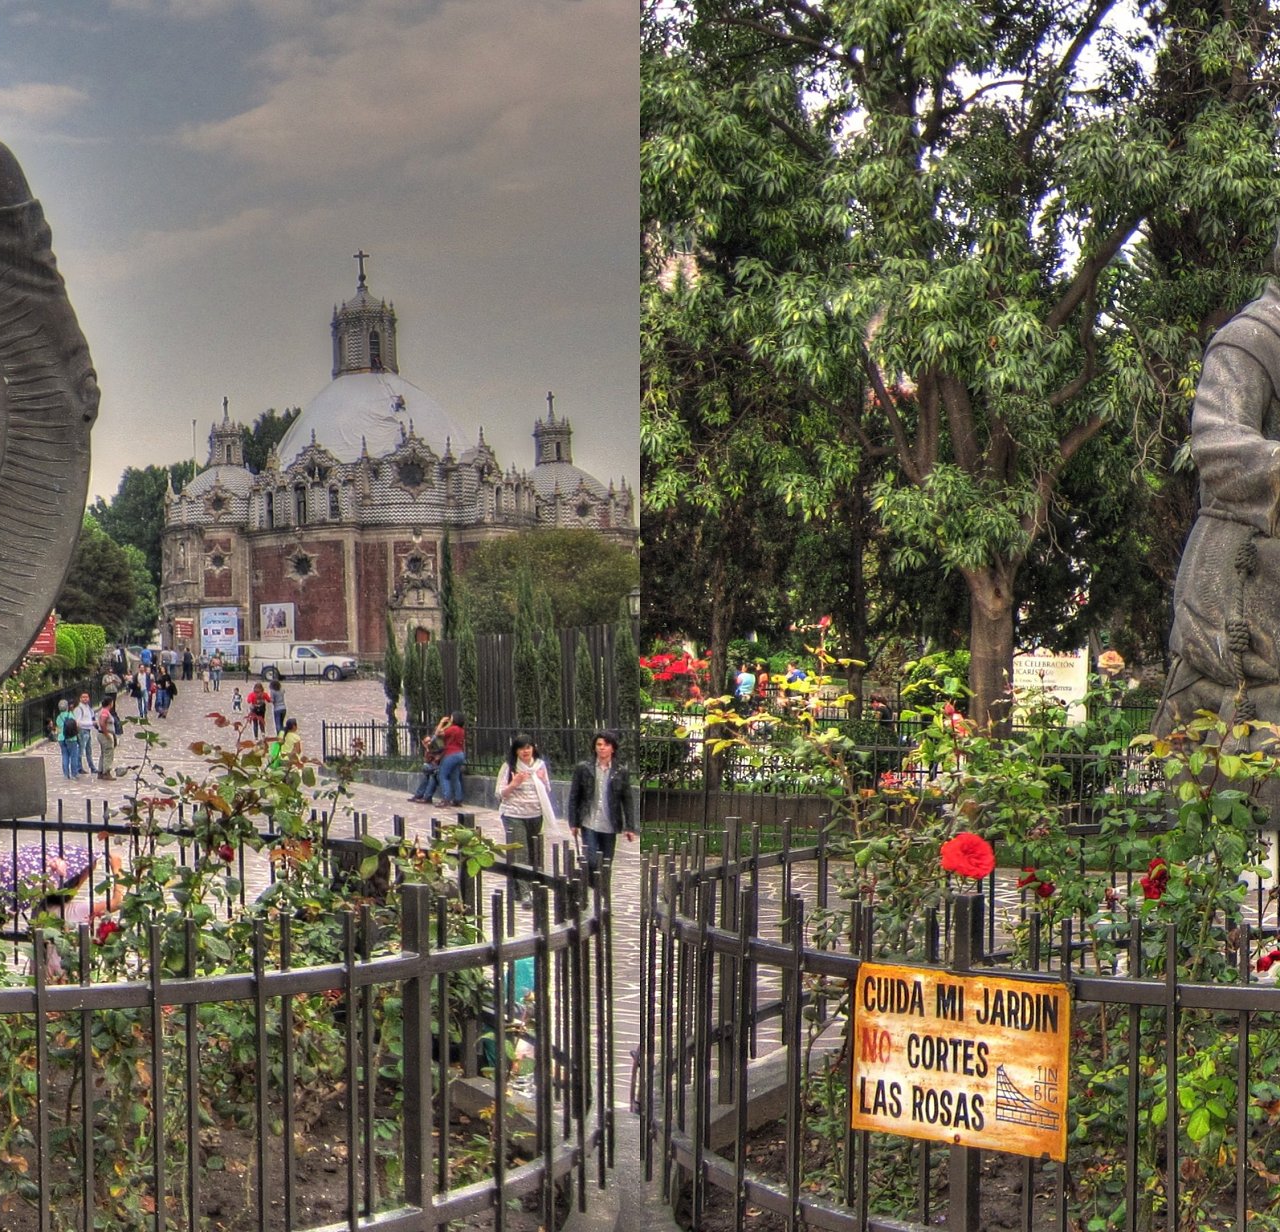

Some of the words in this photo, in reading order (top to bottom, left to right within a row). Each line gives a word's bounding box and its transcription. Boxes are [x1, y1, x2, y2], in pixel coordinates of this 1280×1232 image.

[864, 975, 924, 1017] CUIDA
[936, 983, 964, 1021] MI
[976, 988, 1058, 1033] JARDIN
[861, 1027, 891, 1064] NO
[907, 1033, 990, 1078] CORTES
[859, 1076, 902, 1118] LAS
[912, 1085, 985, 1132] ROSAS
